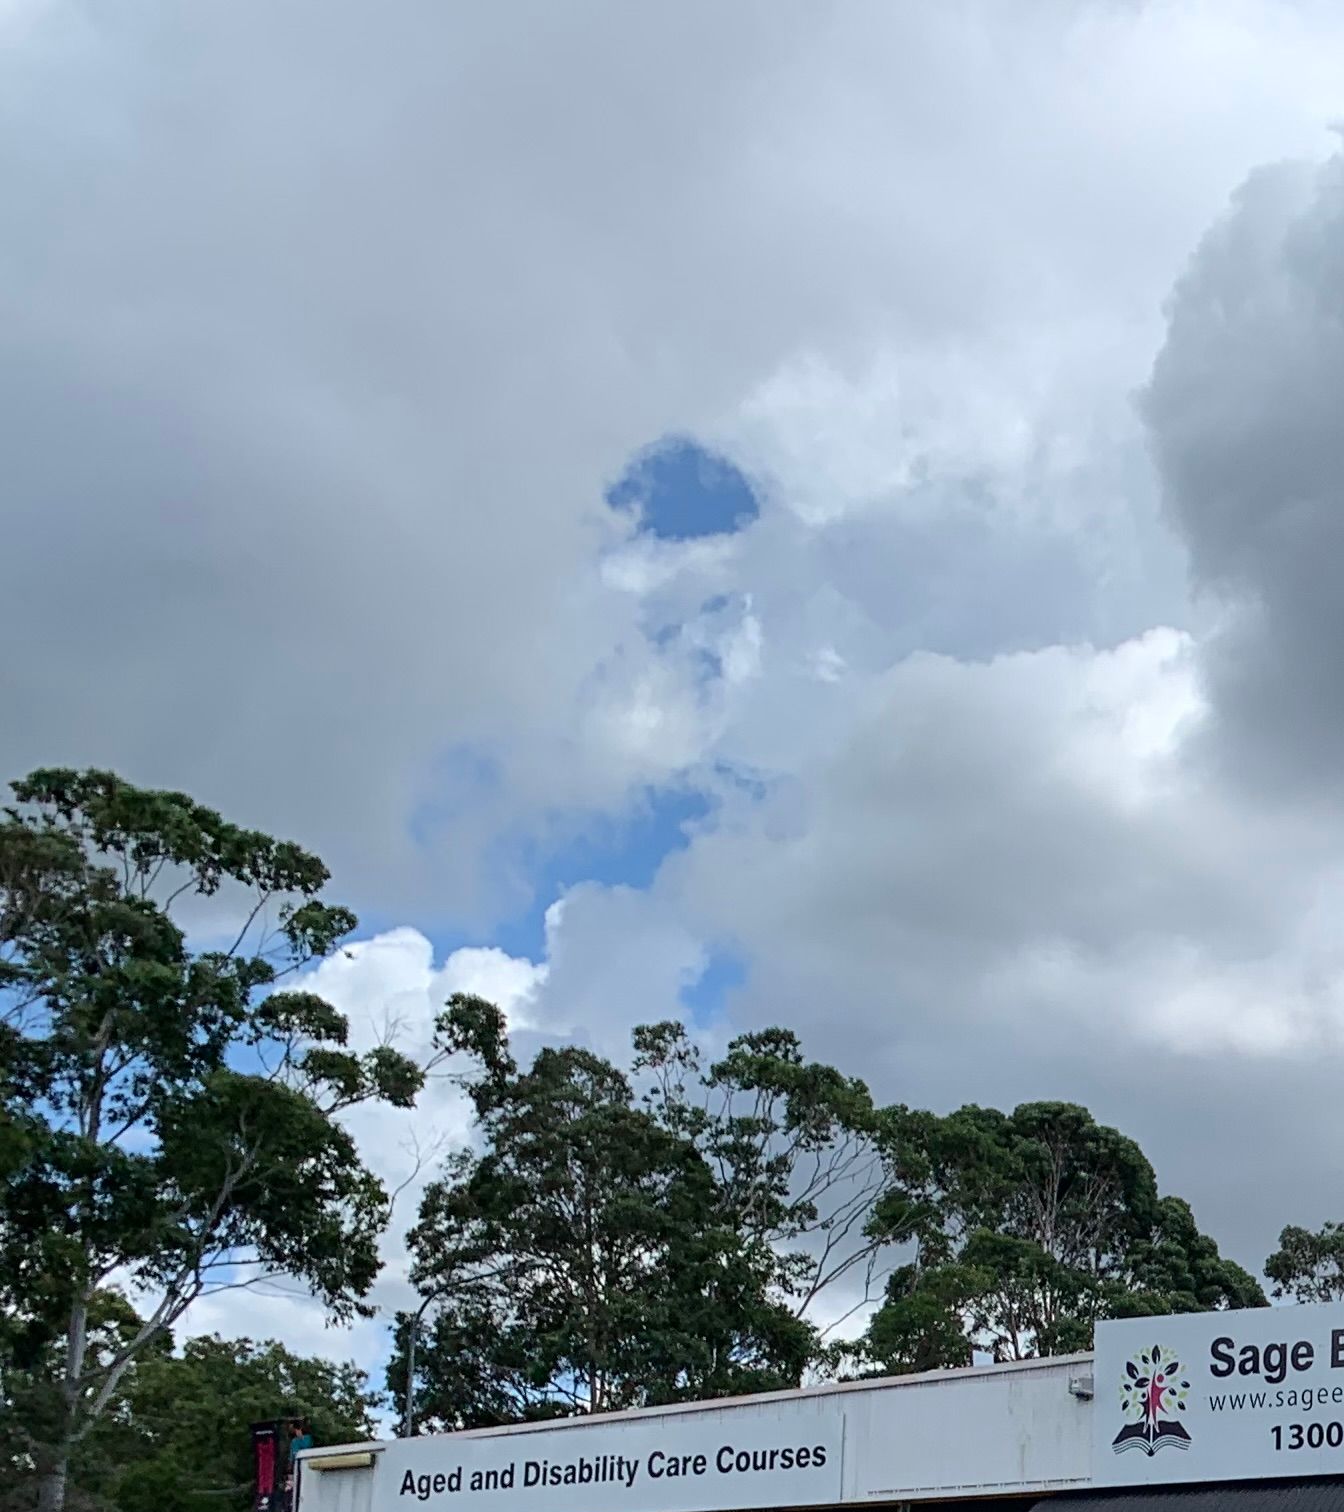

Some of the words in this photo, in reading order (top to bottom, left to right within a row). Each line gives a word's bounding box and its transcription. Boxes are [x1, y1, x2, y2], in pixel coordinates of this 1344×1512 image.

[1209, 1335, 1315, 1385] Sage
[1270, 1420, 1344, 1451] 1300
[399, 1465, 463, 1501] Aged
[469, 1462, 515, 1491] and
[523, 1453, 639, 1489] Disability
[647, 1450, 707, 1478] Care
[715, 1445, 827, 1474] Courses
